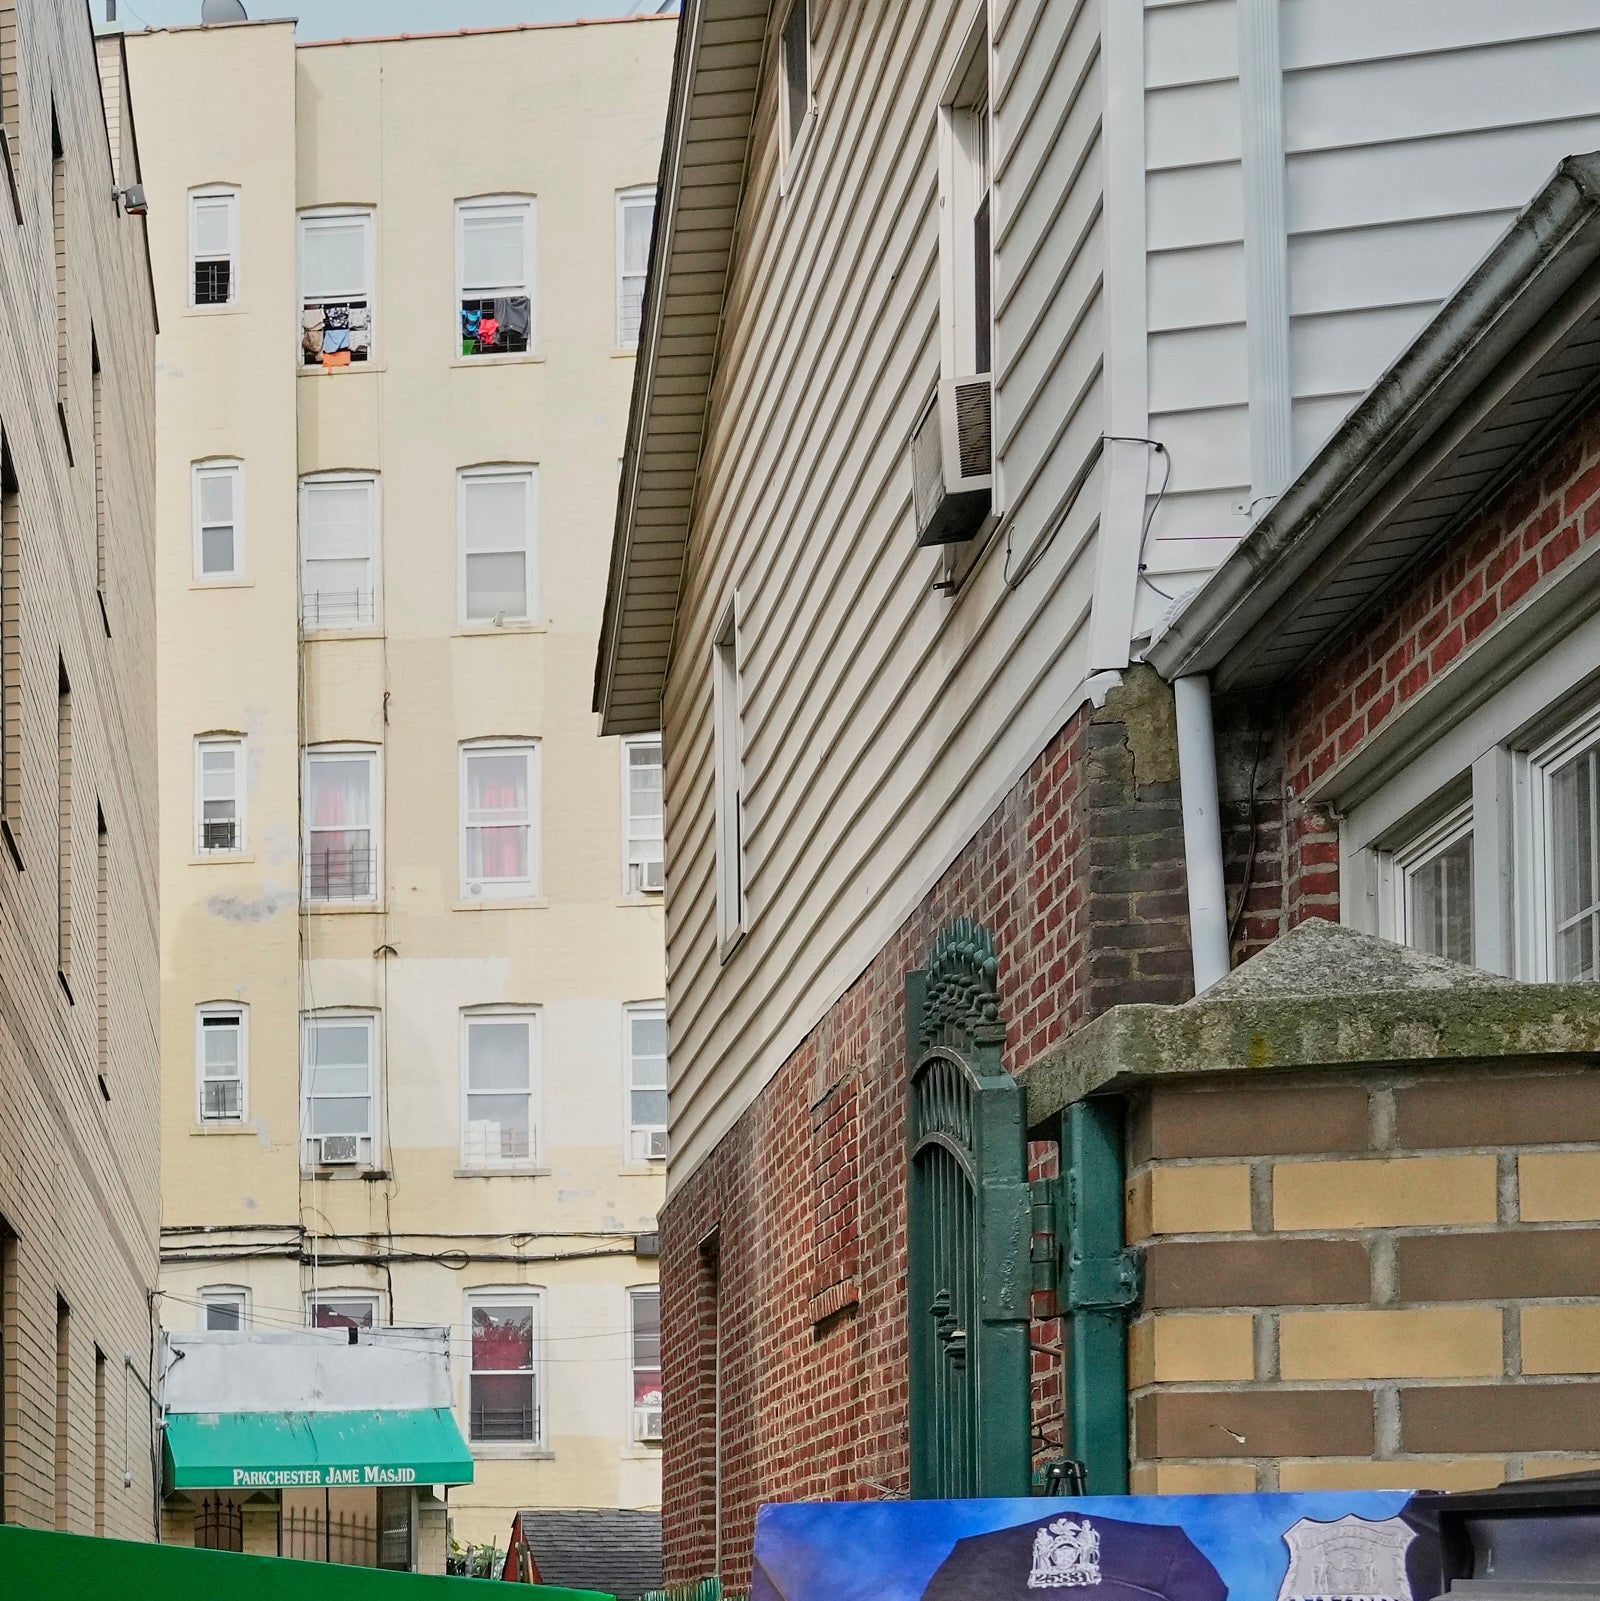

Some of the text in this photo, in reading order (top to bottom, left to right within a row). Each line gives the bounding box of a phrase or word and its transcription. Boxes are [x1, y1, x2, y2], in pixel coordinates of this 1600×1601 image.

[232, 1465, 416, 1486] PARKCHESTER JAME MASJID
